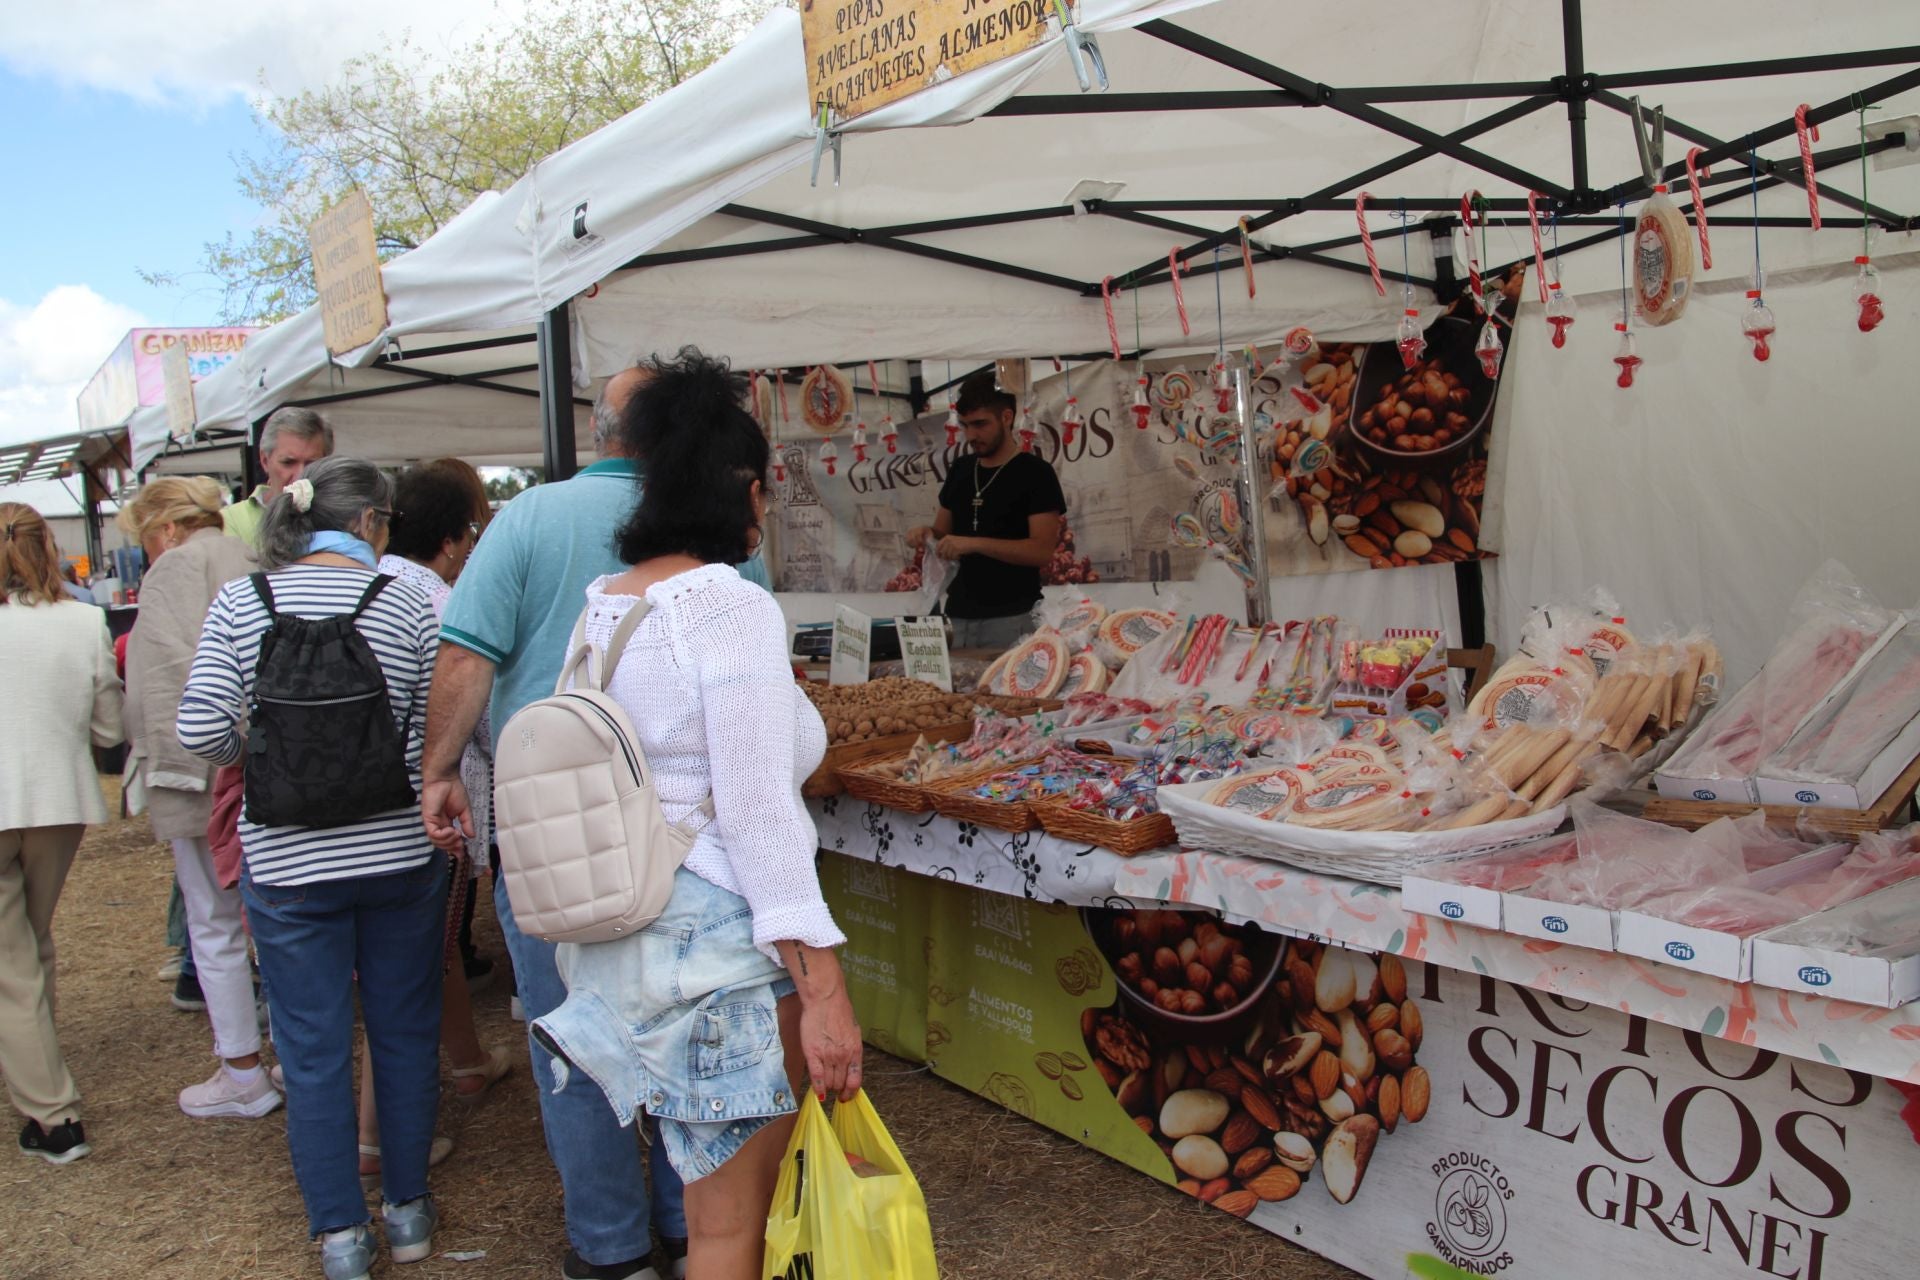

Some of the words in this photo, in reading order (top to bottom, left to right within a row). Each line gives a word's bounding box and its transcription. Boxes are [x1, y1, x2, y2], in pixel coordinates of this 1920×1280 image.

[836, 0, 884, 34] PIPAS
[816, 10, 916, 86] AVELLANAS
[1694, 790, 1715, 800] Fini
[1797, 791, 1819, 802] Fini
[1441, 903, 1462, 917] Fini
[1544, 918, 1567, 932] Fini
[1667, 943, 1692, 959] Fini
[1801, 967, 1828, 984] Fini
[968, 986, 1034, 1022] ALIMENTOS
[982, 1005, 1033, 1034] VALLADOLID
[1463, 1026, 1851, 1219] SECOS
[1432, 1151, 1515, 1200] PRODUCTOS
[1426, 1222, 1514, 1276] GARRAPIÑADOS
